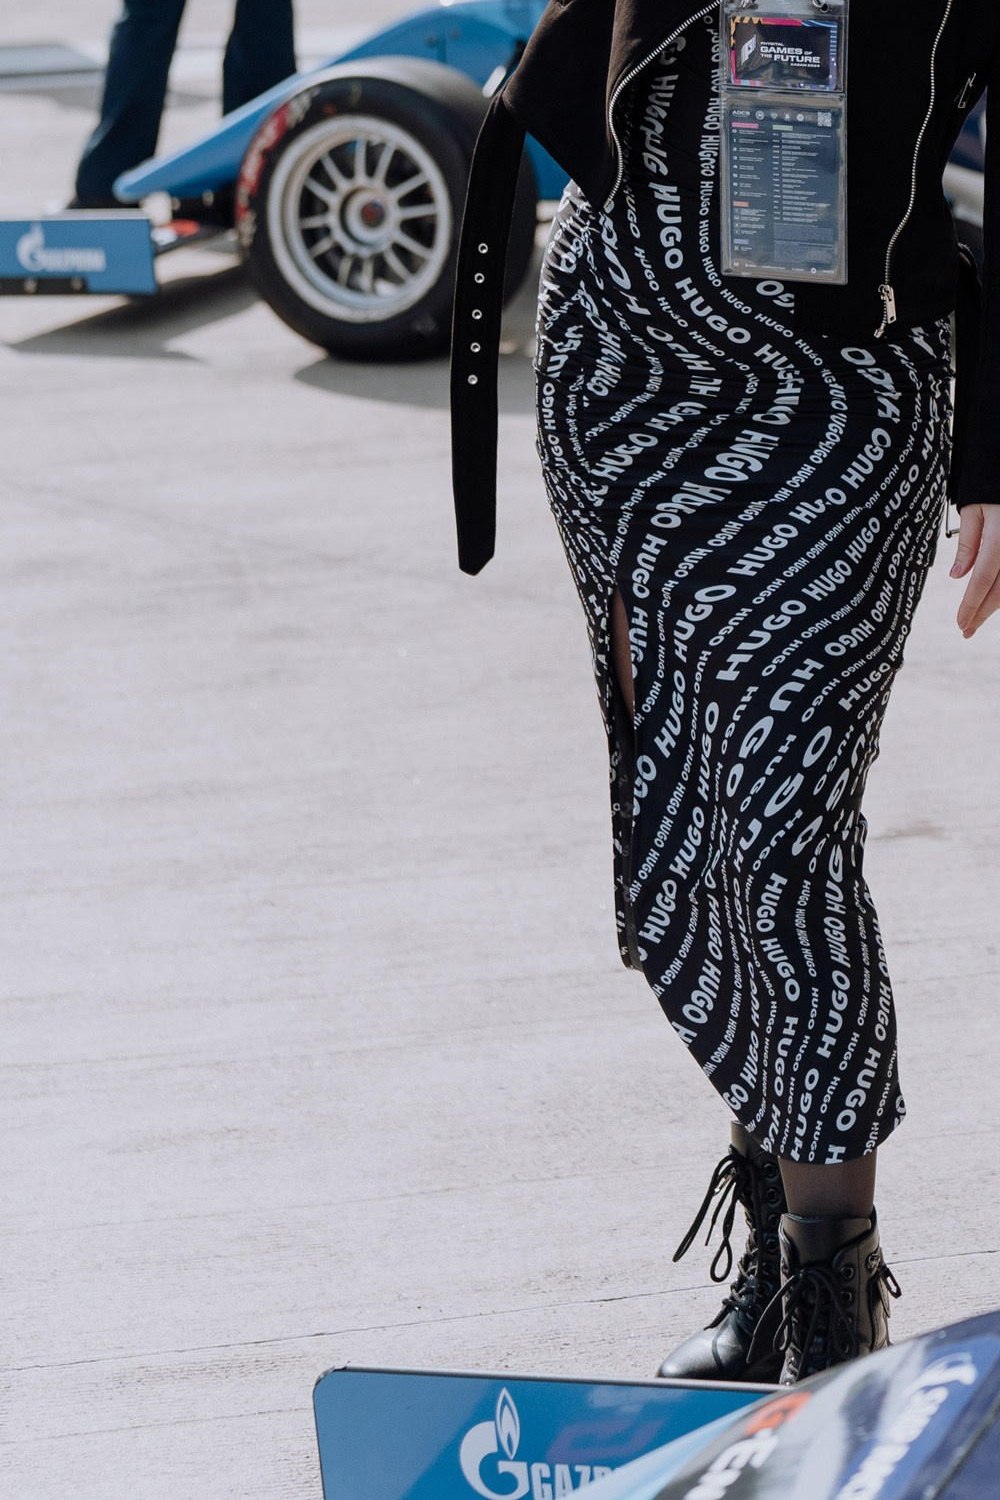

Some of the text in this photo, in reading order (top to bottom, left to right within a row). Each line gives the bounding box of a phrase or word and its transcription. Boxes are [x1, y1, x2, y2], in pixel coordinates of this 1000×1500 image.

[760, 46, 802, 54] GAMES
[774, 55, 820, 64] FUTURE
[649, 182, 683, 269] HUGO
[634, 246, 659, 291] HUGO
[674, 276, 751, 344] HUGO
[689, 331, 725, 357] HUGO
[610, 401, 638, 422] HUGO
[590, 433, 659, 481] HUGO
[685, 427, 712, 448] HUGO
[641, 220, 823, 713] HUGO HUGO HUGO HUGO HUGO HUGO HUGO HUGO HUGO HUGO HUGO HUGO
[609, 535, 625, 567] HUGO
[632, 533, 668, 599] HUGO
[888, 526, 913, 580] HUGO
[654, 427, 891, 758] HUGO HUGO HUGO HUGO
[870, 580, 894, 623] HUGO
[824, 619, 876, 657] HUGO
[866, 645, 883, 660] HUGO
[881, 630, 892, 647] HUGO
[638, 465, 900, 880] HUGO HUGO HUGO HUGO HUGO HUGO HUGO HUGO HUGO HUGO HUGO HUGO
[841, 658, 867, 678] HUGO
[801, 678, 841, 723] HUGO
[857, 692, 879, 720] HUGO
[638, 517, 880, 944] HUGO HUGO HUGO HUGO HUGO HUGO
[660, 484, 925, 986] HUGO HUGO HUGO HUGO HUGO HUGO HUGO HUGO HUGO HUGO HUGO HUGO HUGO
[726, 658, 824, 798] HUGO
[740, 734, 797, 812] HUGO
[813, 725, 854, 795] HUGO
[733, 572, 918, 1089] HUGO HUGO HUGO HUGO HUGO HUGO
[752, 808, 803, 872] HUGO
[707, 894, 723, 961] HUGO
[724, 895, 733, 929] HUGO
[729, 932, 739, 961] HUGO
[802, 948, 817, 977] HUGO
[682, 958, 722, 1024] HUGO
[734, 962, 743, 989] HUGO
[756, 872, 800, 1097] HUGO HUGO HUGO
[759, 970, 775, 996] HUGO
[730, 990, 742, 1018] HUGO
[766, 1001, 777, 1034] HUGO
[808, 987, 819, 1030] HUGO
[874, 981, 892, 1042] HUGO
[727, 1018, 737, 1043] HUGO
[790, 916, 851, 1162] HUGO HUGO HUGO
[808, 915, 871, 1162] HUGO HUGO HUGO HUGO HUGO HUGO HUGO
[710, 1042, 731, 1063] HUGO
[793, 1035, 810, 1072] HUGO
[787, 1076, 796, 1114] HUGO
[835, 1047, 881, 1132] HUGO
[877, 1083, 891, 1117] HUGO
[780, 1119, 790, 1153] HUGO
